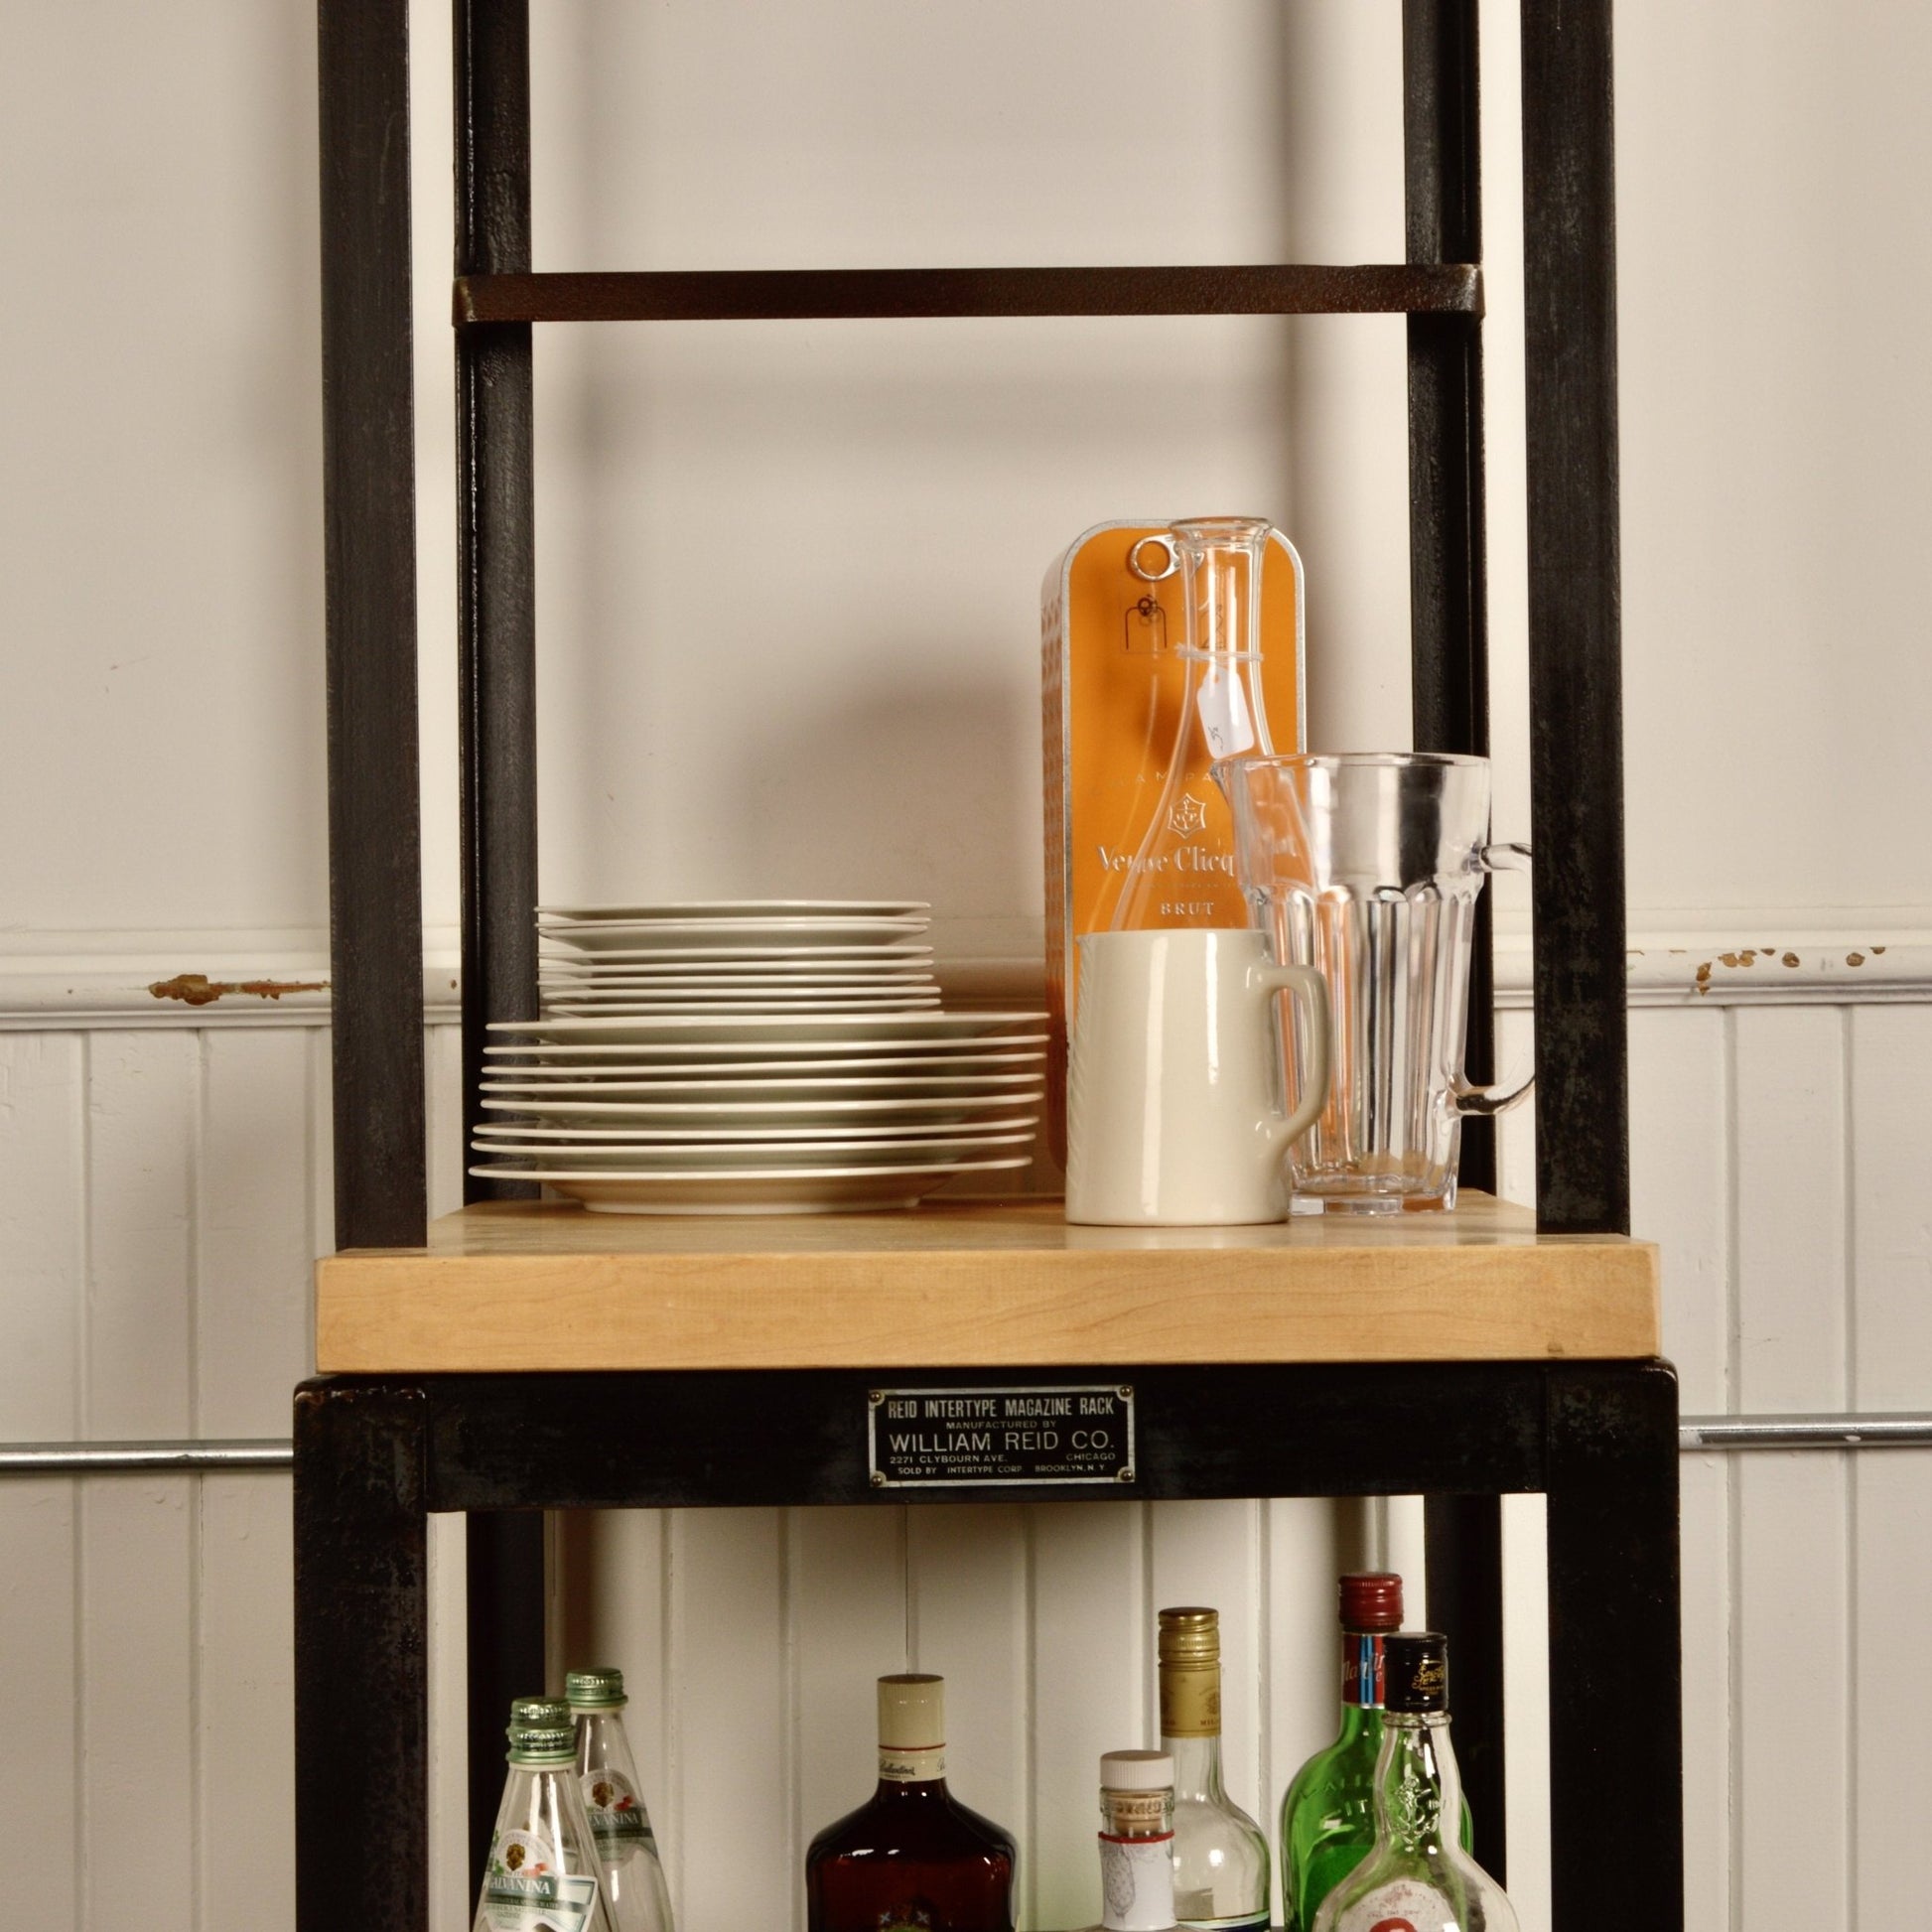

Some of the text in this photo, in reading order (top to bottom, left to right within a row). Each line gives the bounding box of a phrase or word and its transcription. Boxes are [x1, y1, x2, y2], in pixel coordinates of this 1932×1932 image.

[1173, 846, 1235, 878] Clicq
[1160, 901, 1215, 915] BRUT
[888, 1396, 1115, 1419] REID INTERTYPE MAGAZINE RACK
[945, 1420, 1057, 1430] MANUFACTURED BY
[889, 1430, 1115, 1452] WILLIAM REID CO.
[890, 1455, 913, 1464] 2271
[918, 1453, 981, 1464] CLYBOURN
[1065, 1451, 1117, 1462] CHICAGO
[897, 1465, 923, 1475] SOLD
[925, 1465, 938, 1474] BY
[946, 1464, 994, 1474] INTERTYPE
